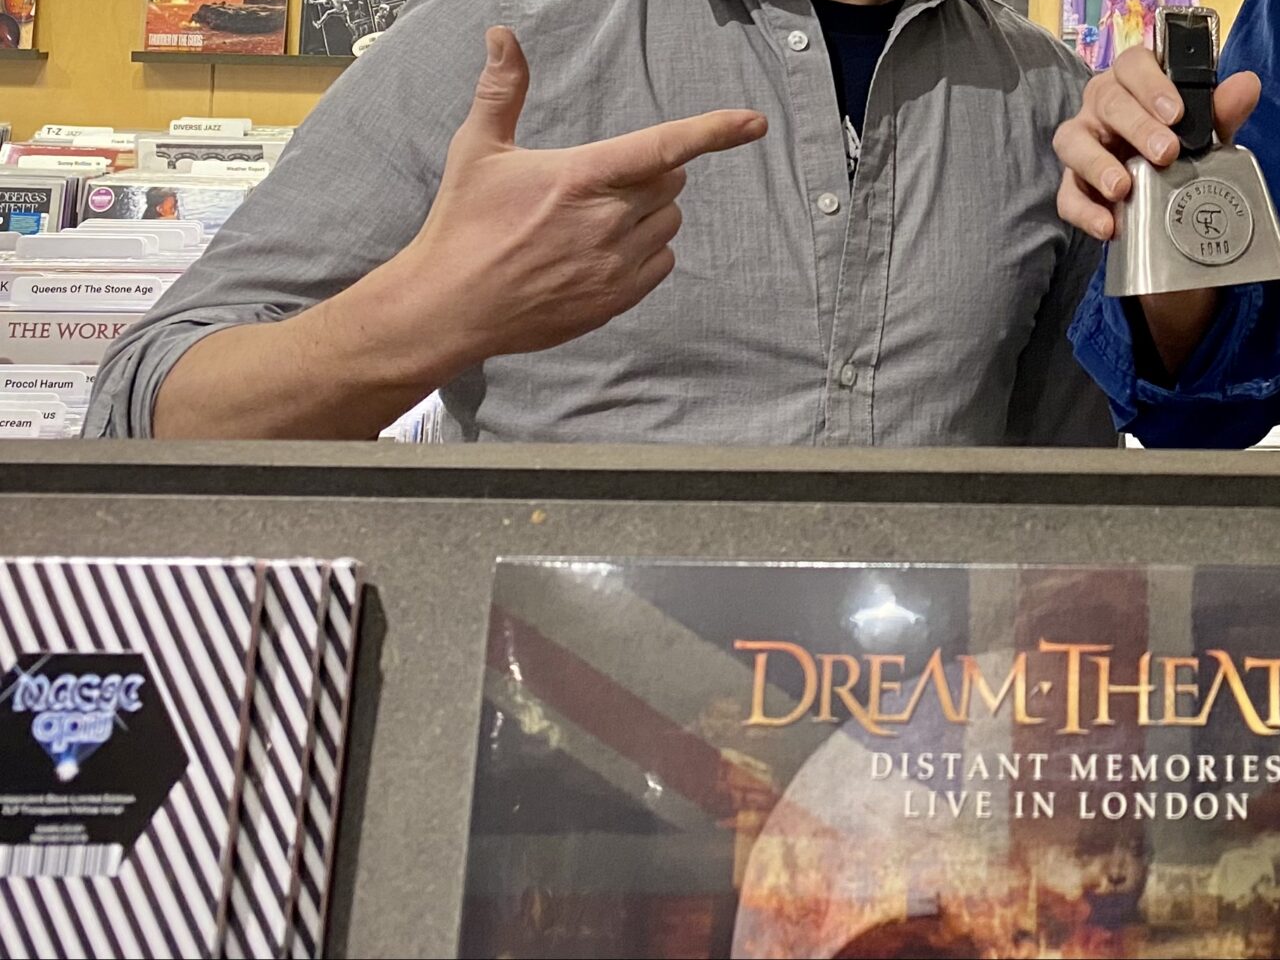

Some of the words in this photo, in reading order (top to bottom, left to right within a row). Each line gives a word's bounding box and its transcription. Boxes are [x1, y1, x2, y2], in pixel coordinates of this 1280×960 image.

[31, 284, 67, 294] Queens
[70, 284, 81, 293] Of
[84, 284, 101, 293] The
[104, 284, 132, 293] Stone
[134, 285, 153, 295] Age
[8, 322, 51, 339] THE
[5, 379, 38, 389] Procol
[40, 379, 74, 389] Harum
[734, 638, 1044, 736] DREAM
[869, 751, 1048, 781] DISTANT
[902, 790, 993, 820] LIVE
[1014, 792, 1056, 820] IN
[1078, 791, 1250, 821] LONDON
